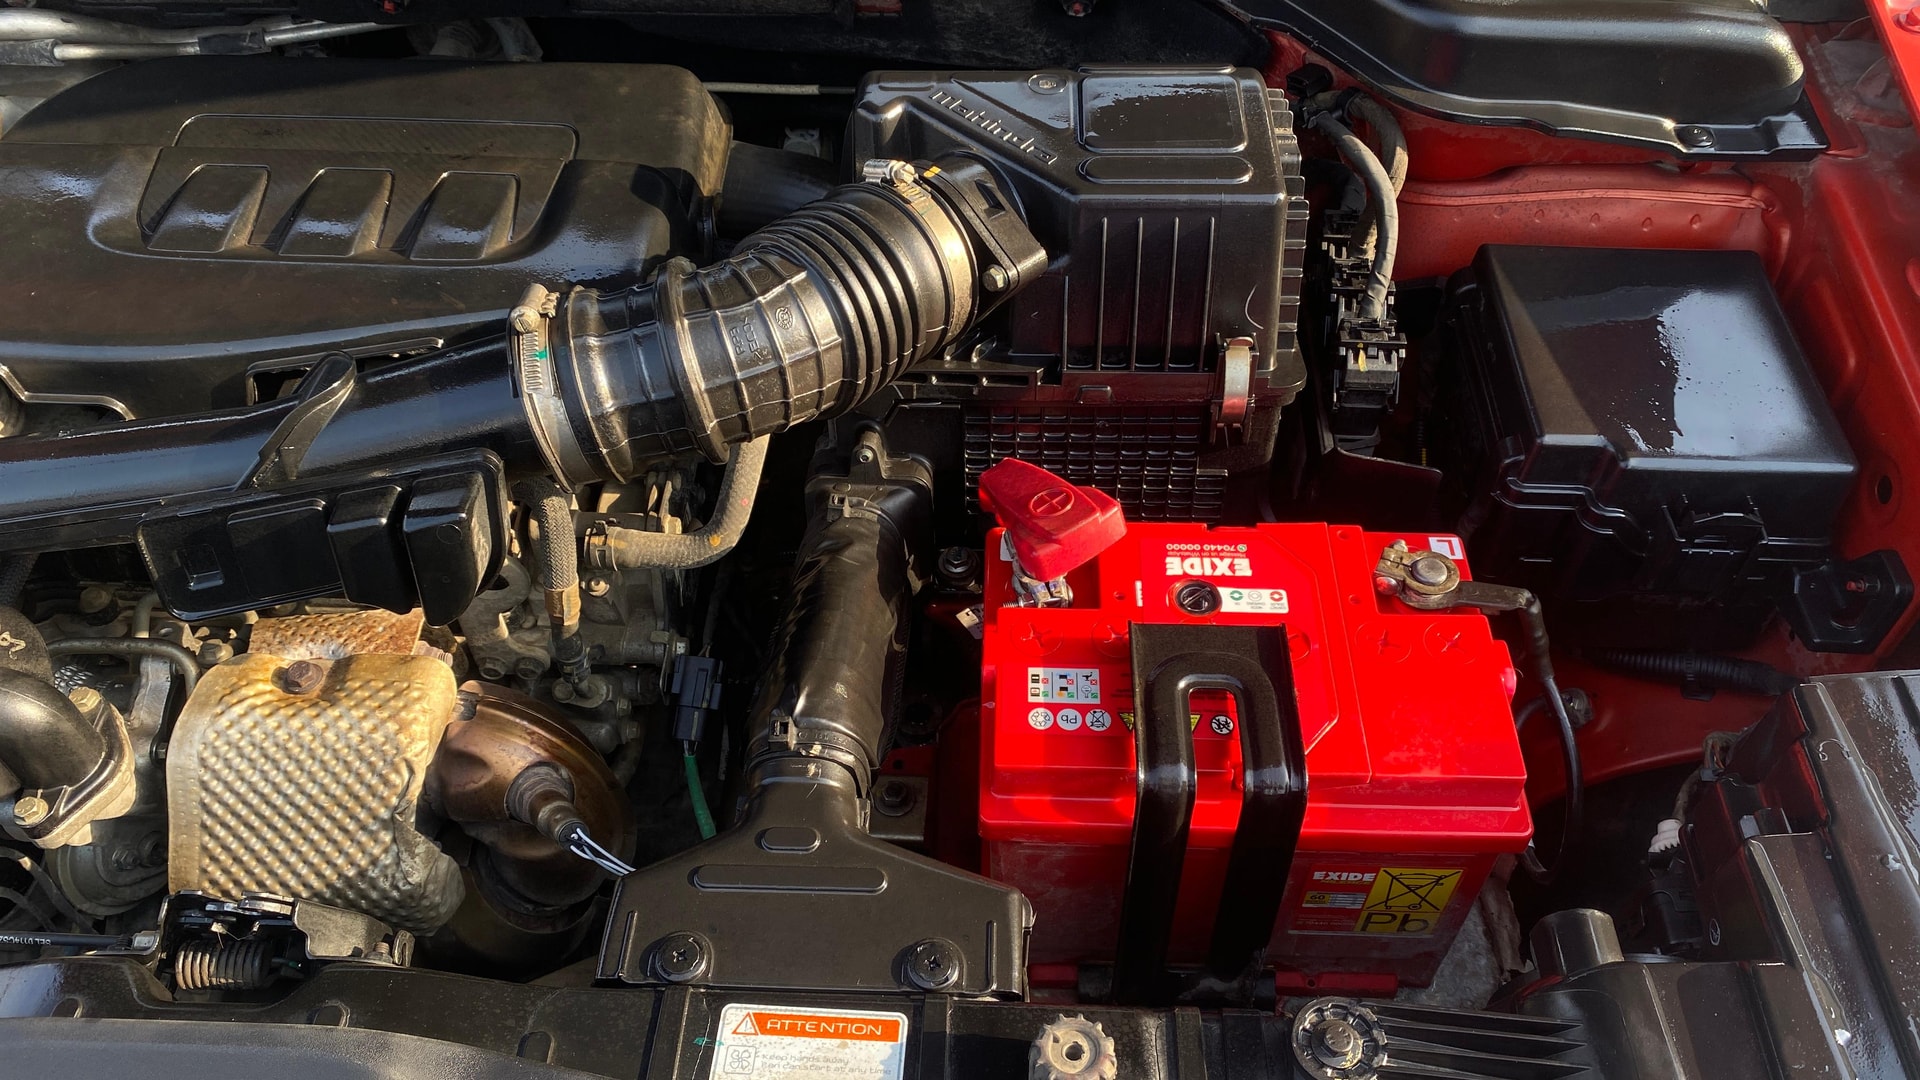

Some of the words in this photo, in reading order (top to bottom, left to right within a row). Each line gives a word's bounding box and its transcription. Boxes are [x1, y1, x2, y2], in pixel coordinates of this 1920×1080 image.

[928, 91, 1058, 165] mahindra
[1166, 543, 1201, 551] 00000
[1203, 544, 1236, 552] 70440
[1165, 557, 1252, 576] EXIDE
[1060, 714, 1078, 724] Pb
[1312, 871, 1377, 882] EXIDE
[1360, 912, 1430, 933] Pb
[766, 1019, 882, 1036] ATTENTION
